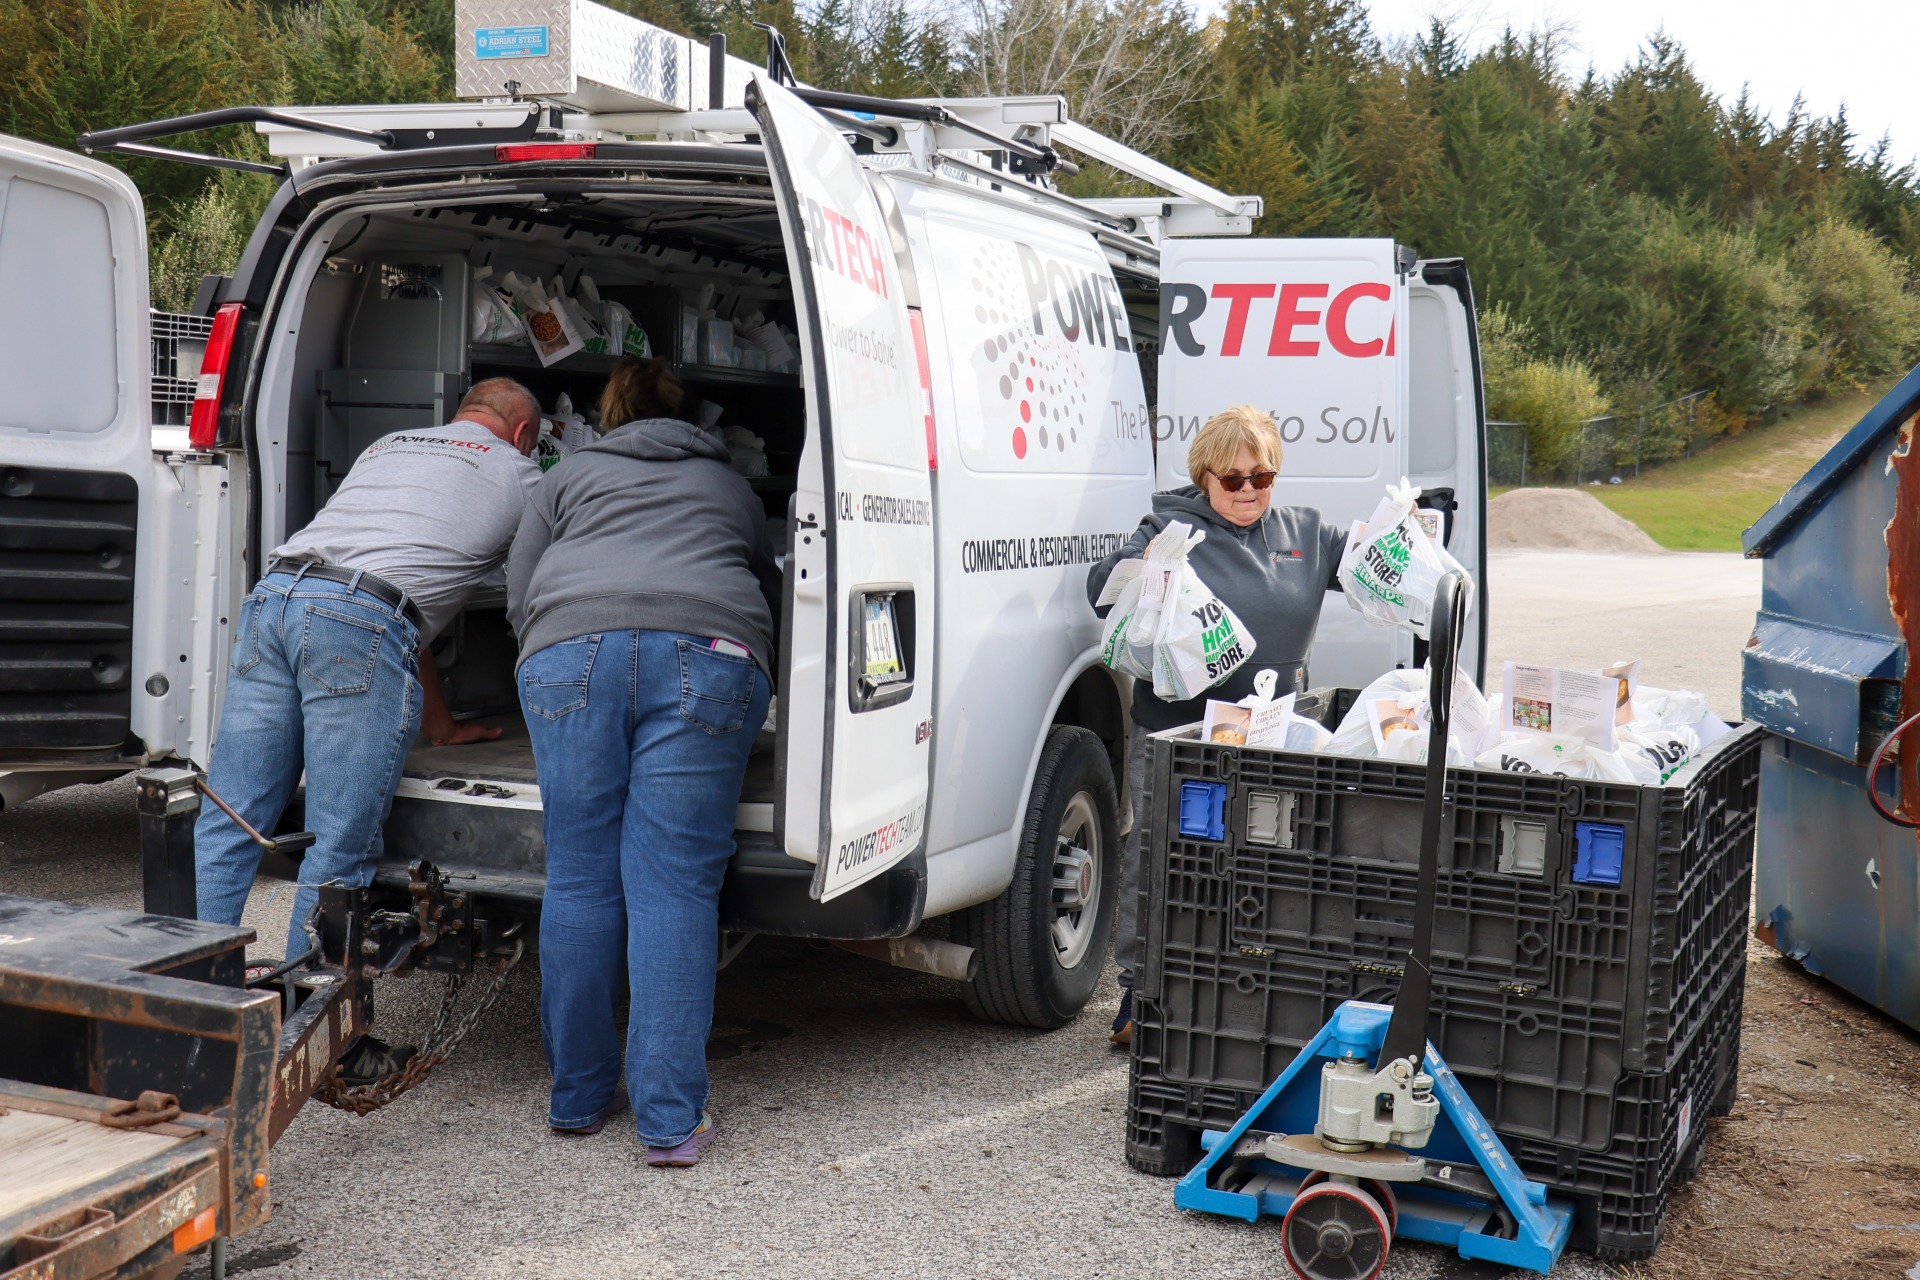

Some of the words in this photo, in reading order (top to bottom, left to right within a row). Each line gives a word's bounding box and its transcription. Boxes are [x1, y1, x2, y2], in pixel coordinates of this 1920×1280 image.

[489, 37, 517, 46] ADRIAN
[518, 35, 542, 44] STEEL
[1015, 241, 1136, 353] POWE
[1158, 282, 1395, 358] RTEC
[861, 332, 871, 358] to
[1111, 400, 1135, 439] The
[391, 435, 492, 453] POWERTECH
[448, 454, 480, 469] MAINTENANCE
[862, 494, 897, 524] GENERATOR
[898, 497, 911, 525] SALES
[962, 538, 1029, 574] COMMERCIAL
[1030, 537, 1038, 568] &
[1039, 535, 1090, 567] RESIDENTIAL
[1255, 711, 1282, 724] CHICKEN
[1256, 704, 1283, 718] CREAMY
[1249, 722, 1281, 736] DUMPLINGS
